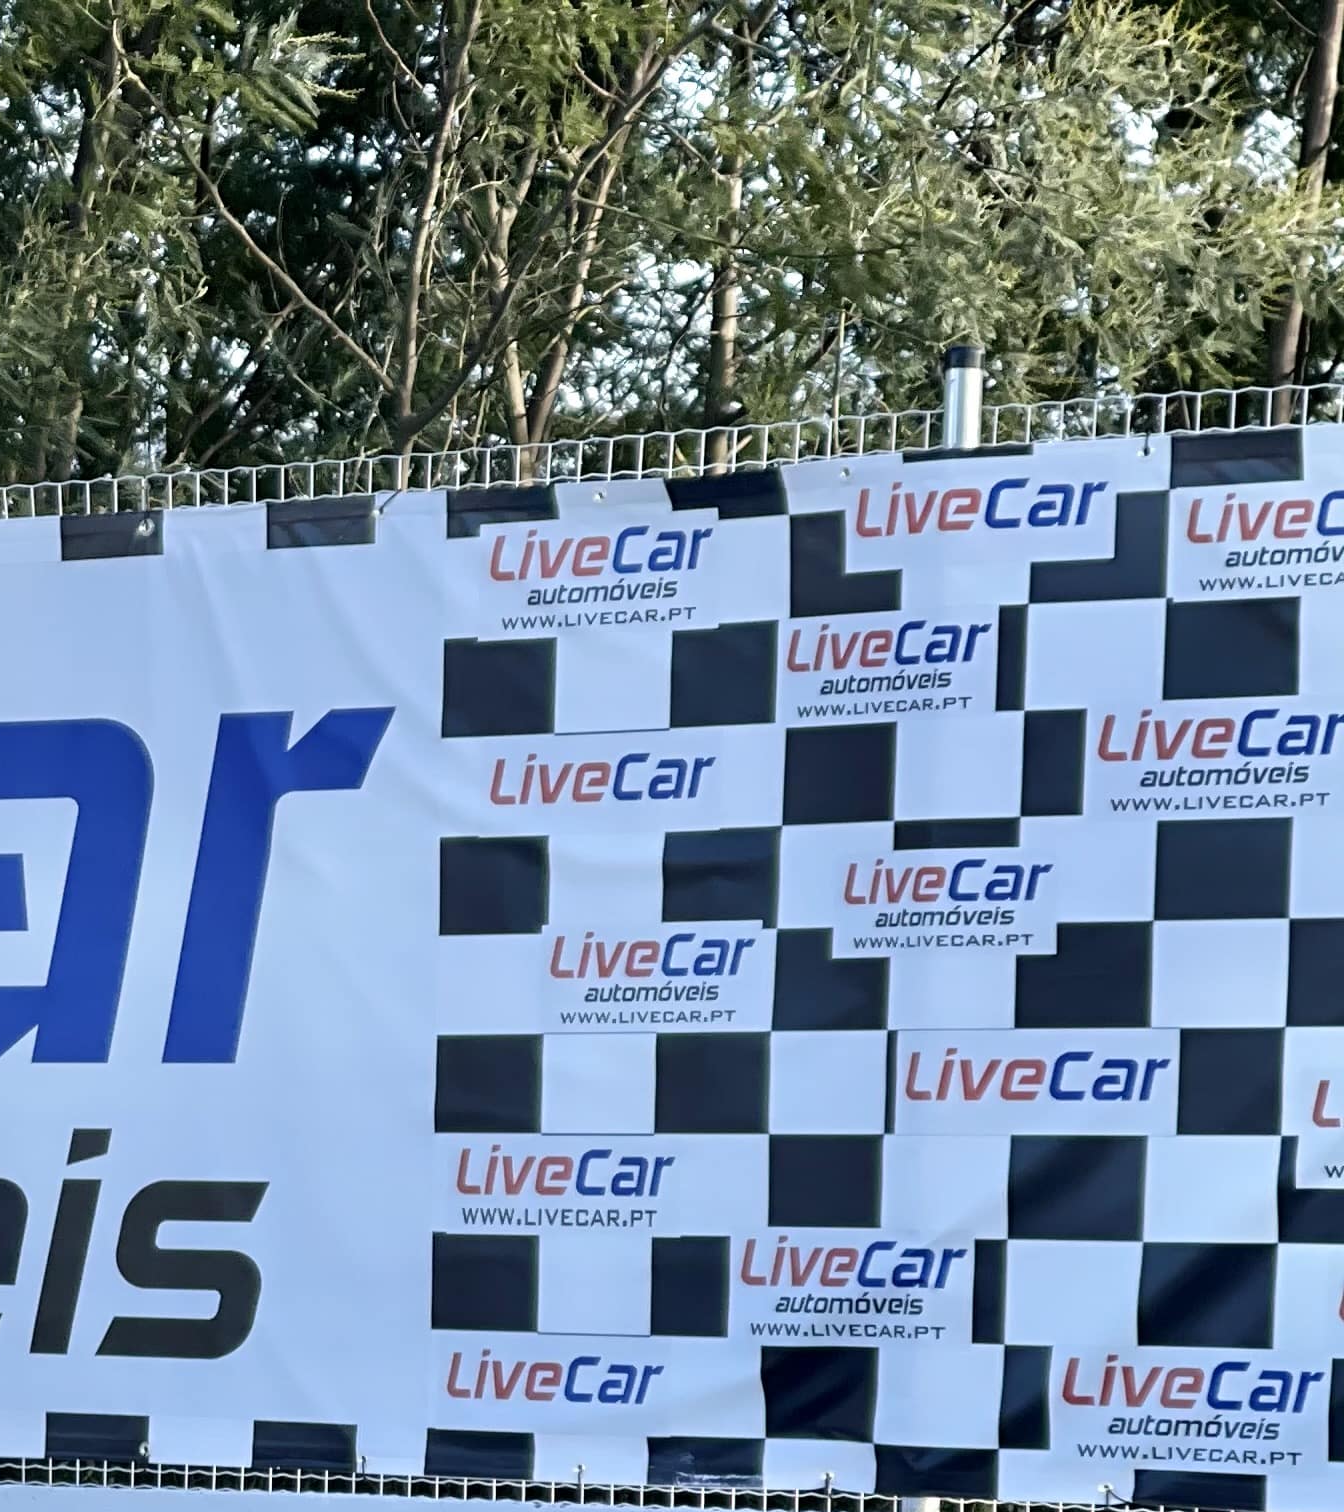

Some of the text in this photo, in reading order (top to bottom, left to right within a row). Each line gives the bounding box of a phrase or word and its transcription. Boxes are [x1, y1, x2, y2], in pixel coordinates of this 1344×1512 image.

[856, 478, 1108, 537] LiveCar
[489, 526, 713, 581] LiveCar
[527, 579, 678, 606] automóveis
[502, 606, 696, 629] WWW.LIVECAR.PT
[786, 619, 991, 672] LiveCar
[820, 668, 951, 695] automóveis
[797, 697, 972, 717] WWW.LIVECAR.PT
[1097, 709, 1344, 761] LiveCar
[489, 753, 715, 805] LiveCar
[1140, 762, 1309, 787] automóveis
[1111, 792, 1330, 811] WWW.LIVECAR.PT
[844, 859, 1052, 904] LiveCar
[875, 905, 1014, 928] automóveis
[853, 933, 1033, 948] WWW.LIVECAR.PT
[550, 932, 755, 979] LiveCar
[584, 980, 719, 1003] automóveis
[561, 1009, 736, 1024] WWW.LIVECAR.PT
[904, 1048, 1171, 1101] LiveCar
[456, 1145, 675, 1197] LiveCar
[462, 1207, 657, 1227] WWW.LIVECAR.PT
[740, 1236, 967, 1288] LiveCar
[775, 1292, 923, 1315] automóveis
[750, 1323, 946, 1340] WWW.LIVECAR.PT
[446, 1349, 664, 1404] LiveCar
[1062, 1354, 1325, 1413] LiveCar
[1108, 1415, 1280, 1440] automóveis
[1077, 1444, 1303, 1466] WWW.LIVECAR.PT
